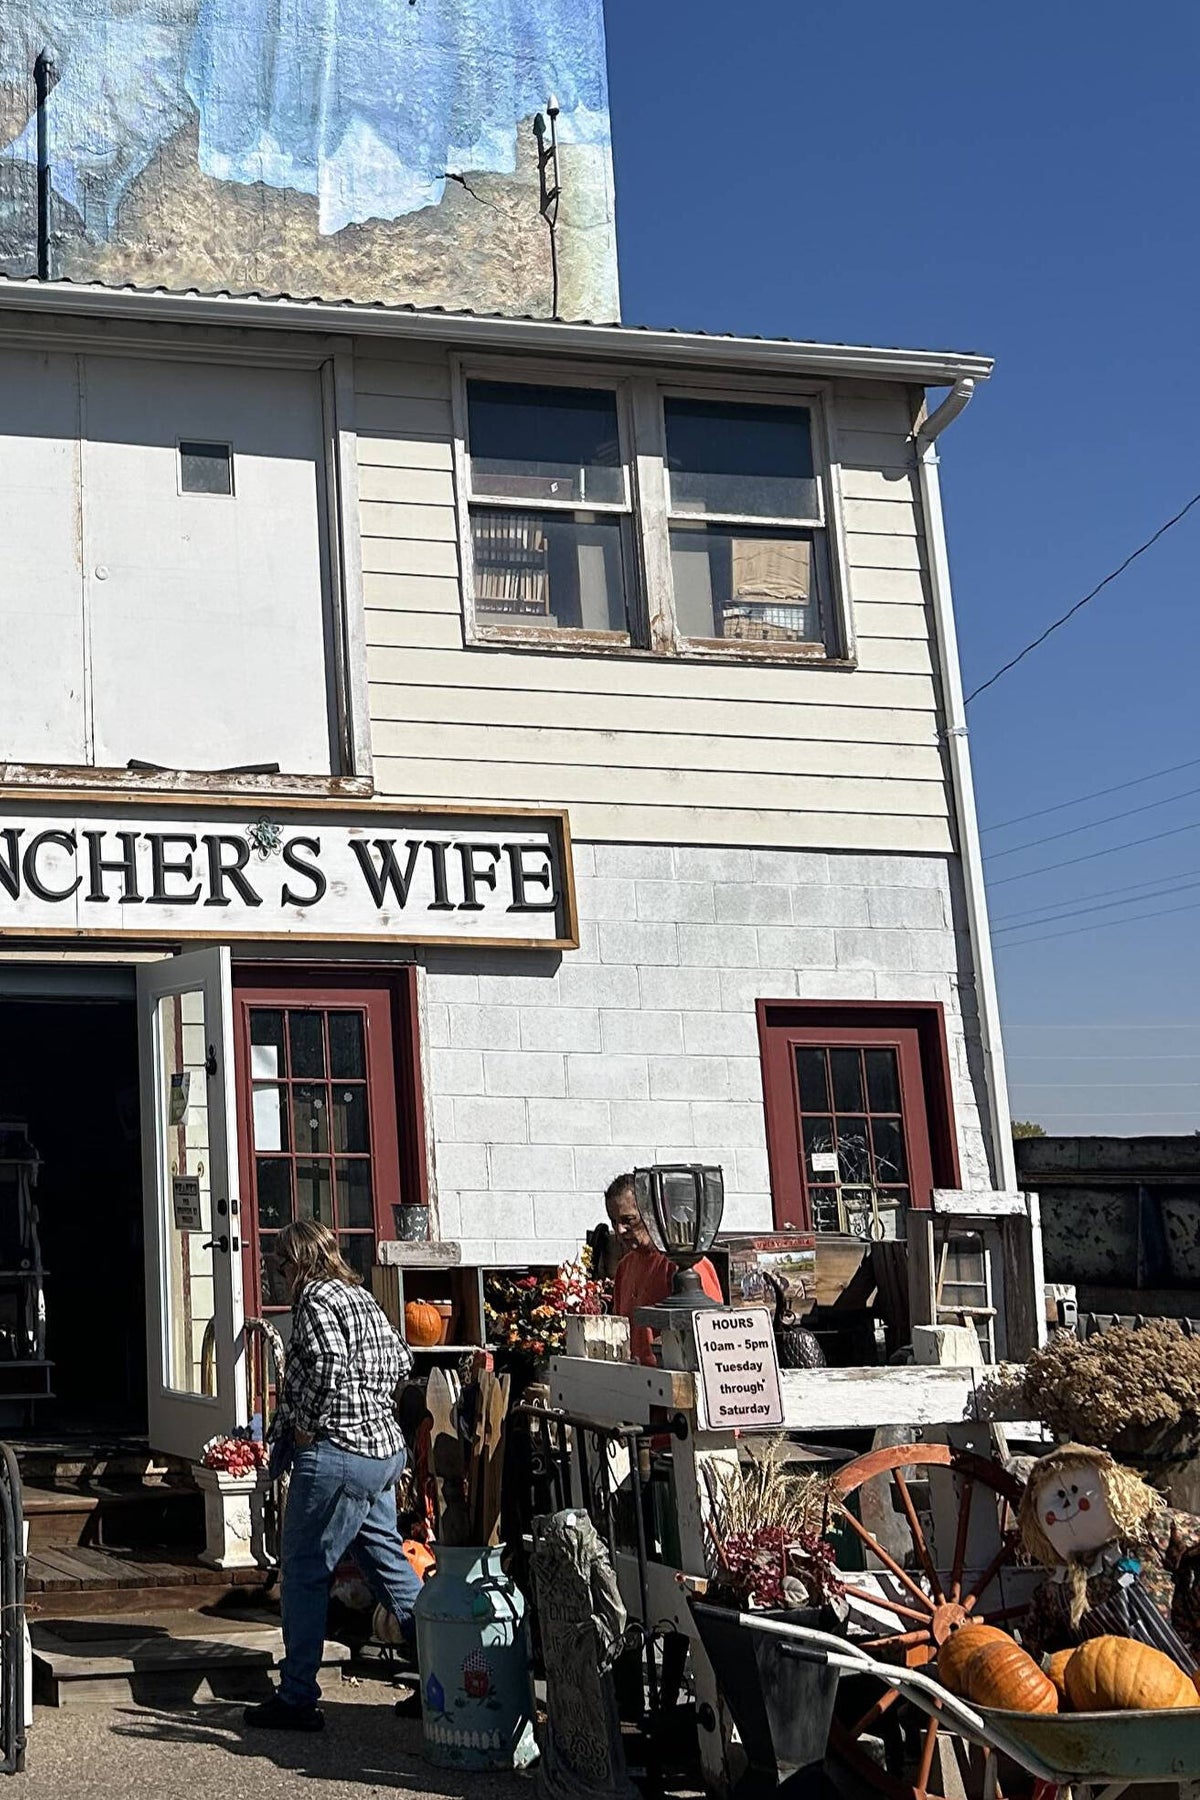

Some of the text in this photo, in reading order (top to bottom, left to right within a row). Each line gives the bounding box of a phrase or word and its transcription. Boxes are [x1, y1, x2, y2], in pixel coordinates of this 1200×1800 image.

[347, 837, 560, 914] WIFE
[712, 1317, 754, 1330] HOURS
[703, 1340, 735, 1352] 10am
[744, 1339, 769, 1351] 5pm
[714, 1361, 763, 1373] Tuesday
[720, 1381, 764, 1395] through
[719, 1404, 771, 1416] Saturday
